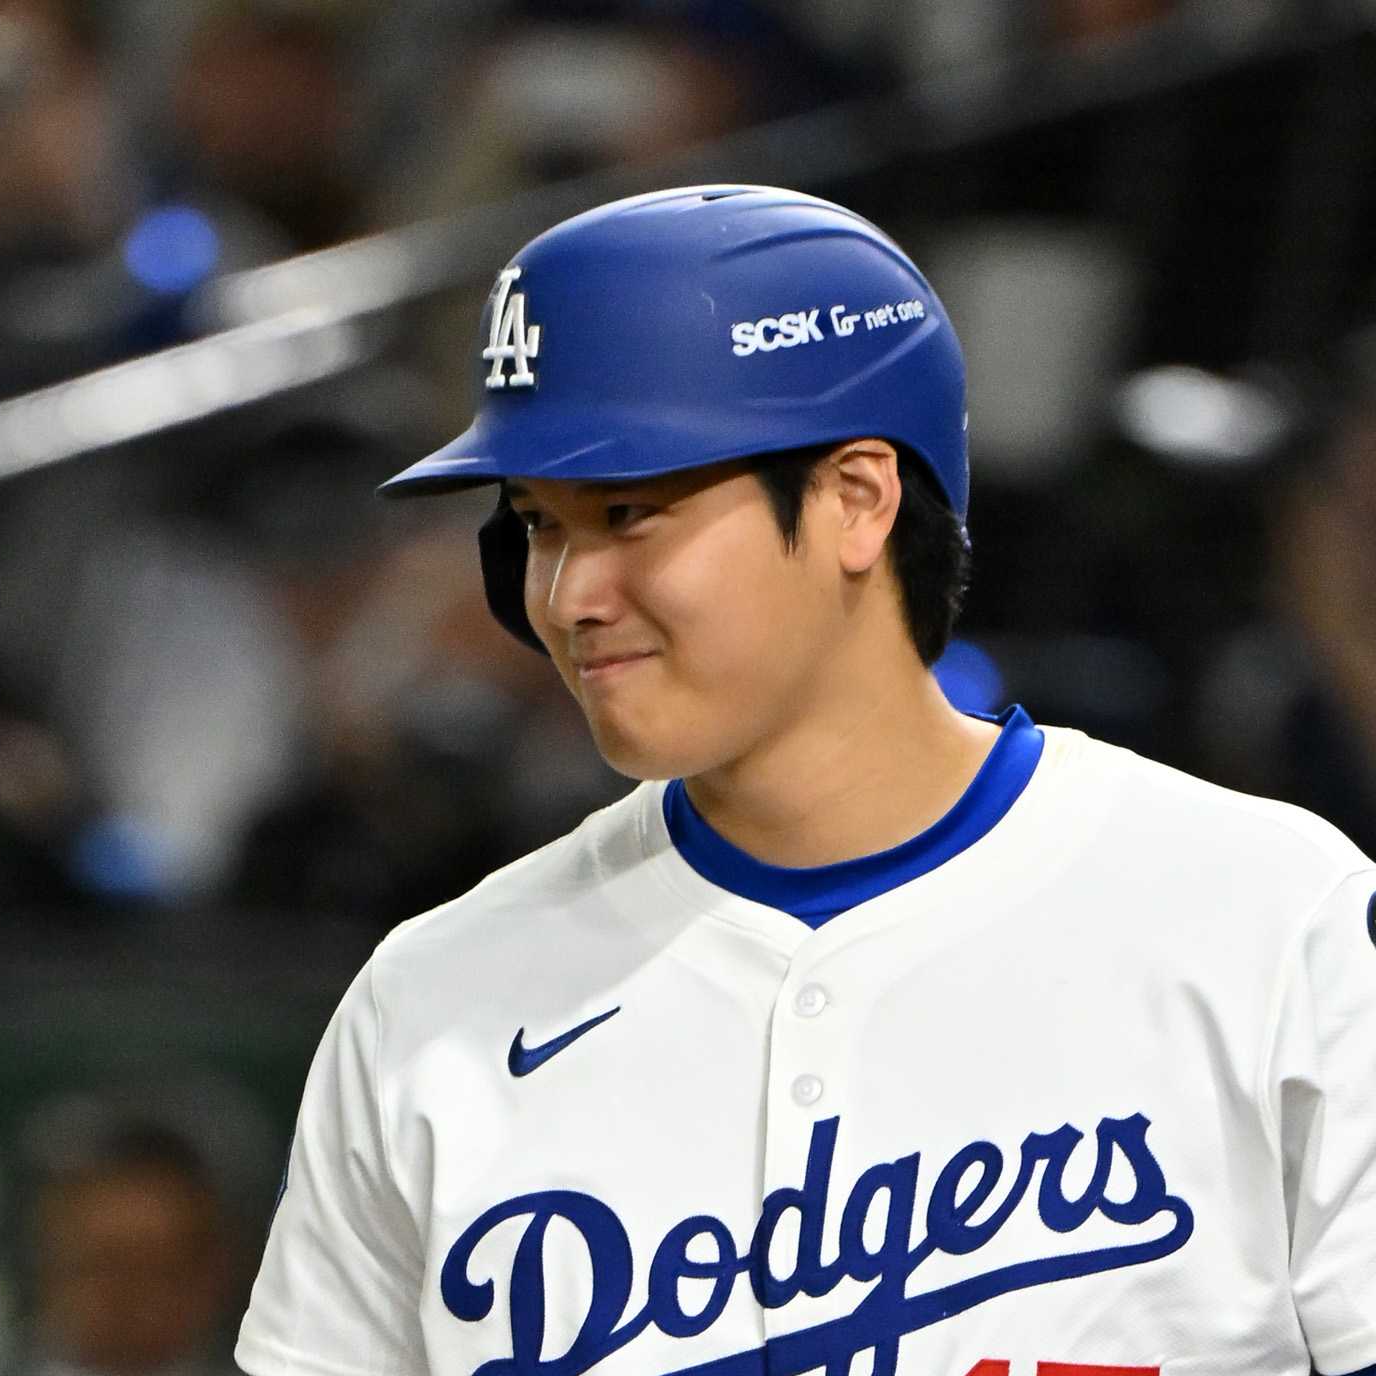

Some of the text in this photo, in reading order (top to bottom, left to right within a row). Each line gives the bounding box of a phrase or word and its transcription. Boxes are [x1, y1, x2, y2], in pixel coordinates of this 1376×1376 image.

[482, 266, 540, 389] LA
[731, 299, 925, 357] SCSK net one
